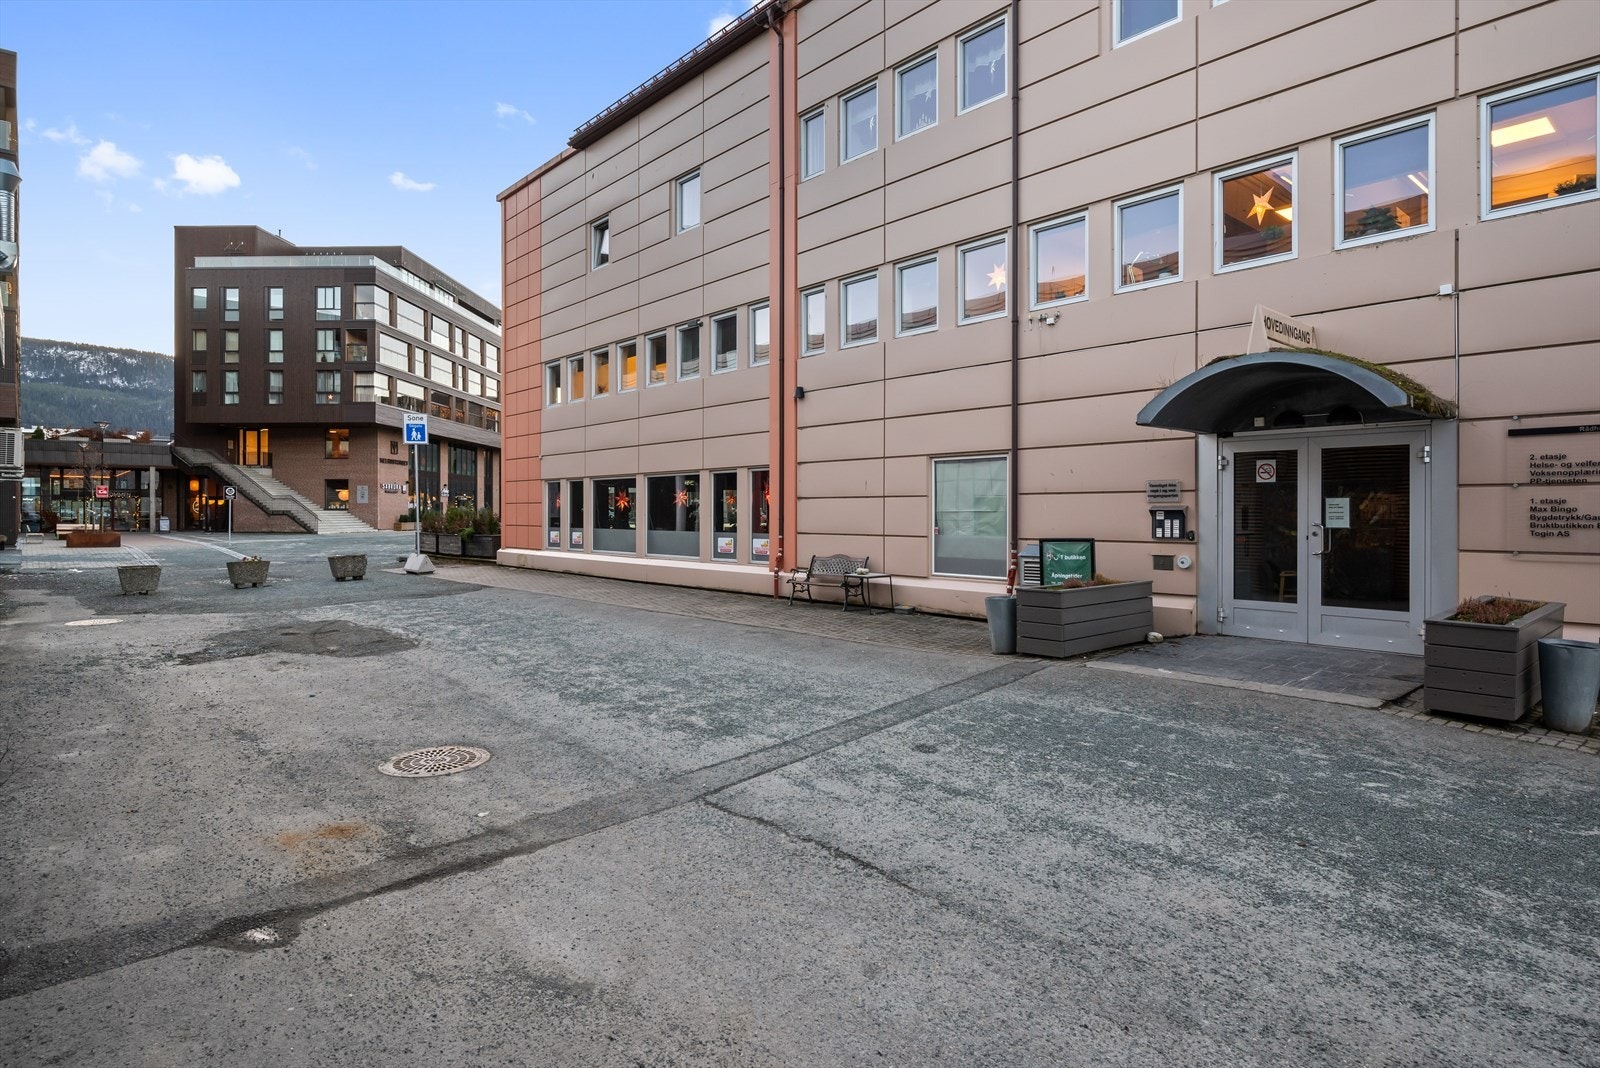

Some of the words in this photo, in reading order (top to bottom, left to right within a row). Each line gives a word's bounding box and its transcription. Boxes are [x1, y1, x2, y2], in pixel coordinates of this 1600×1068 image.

[1540, 453, 1567, 462] etasje
[1529, 478, 1588, 486] PP-tjenesten
[1540, 498, 1567, 506] etasje
[1550, 506, 1578, 514] Bingo
[1529, 530, 1555, 538] Togin
